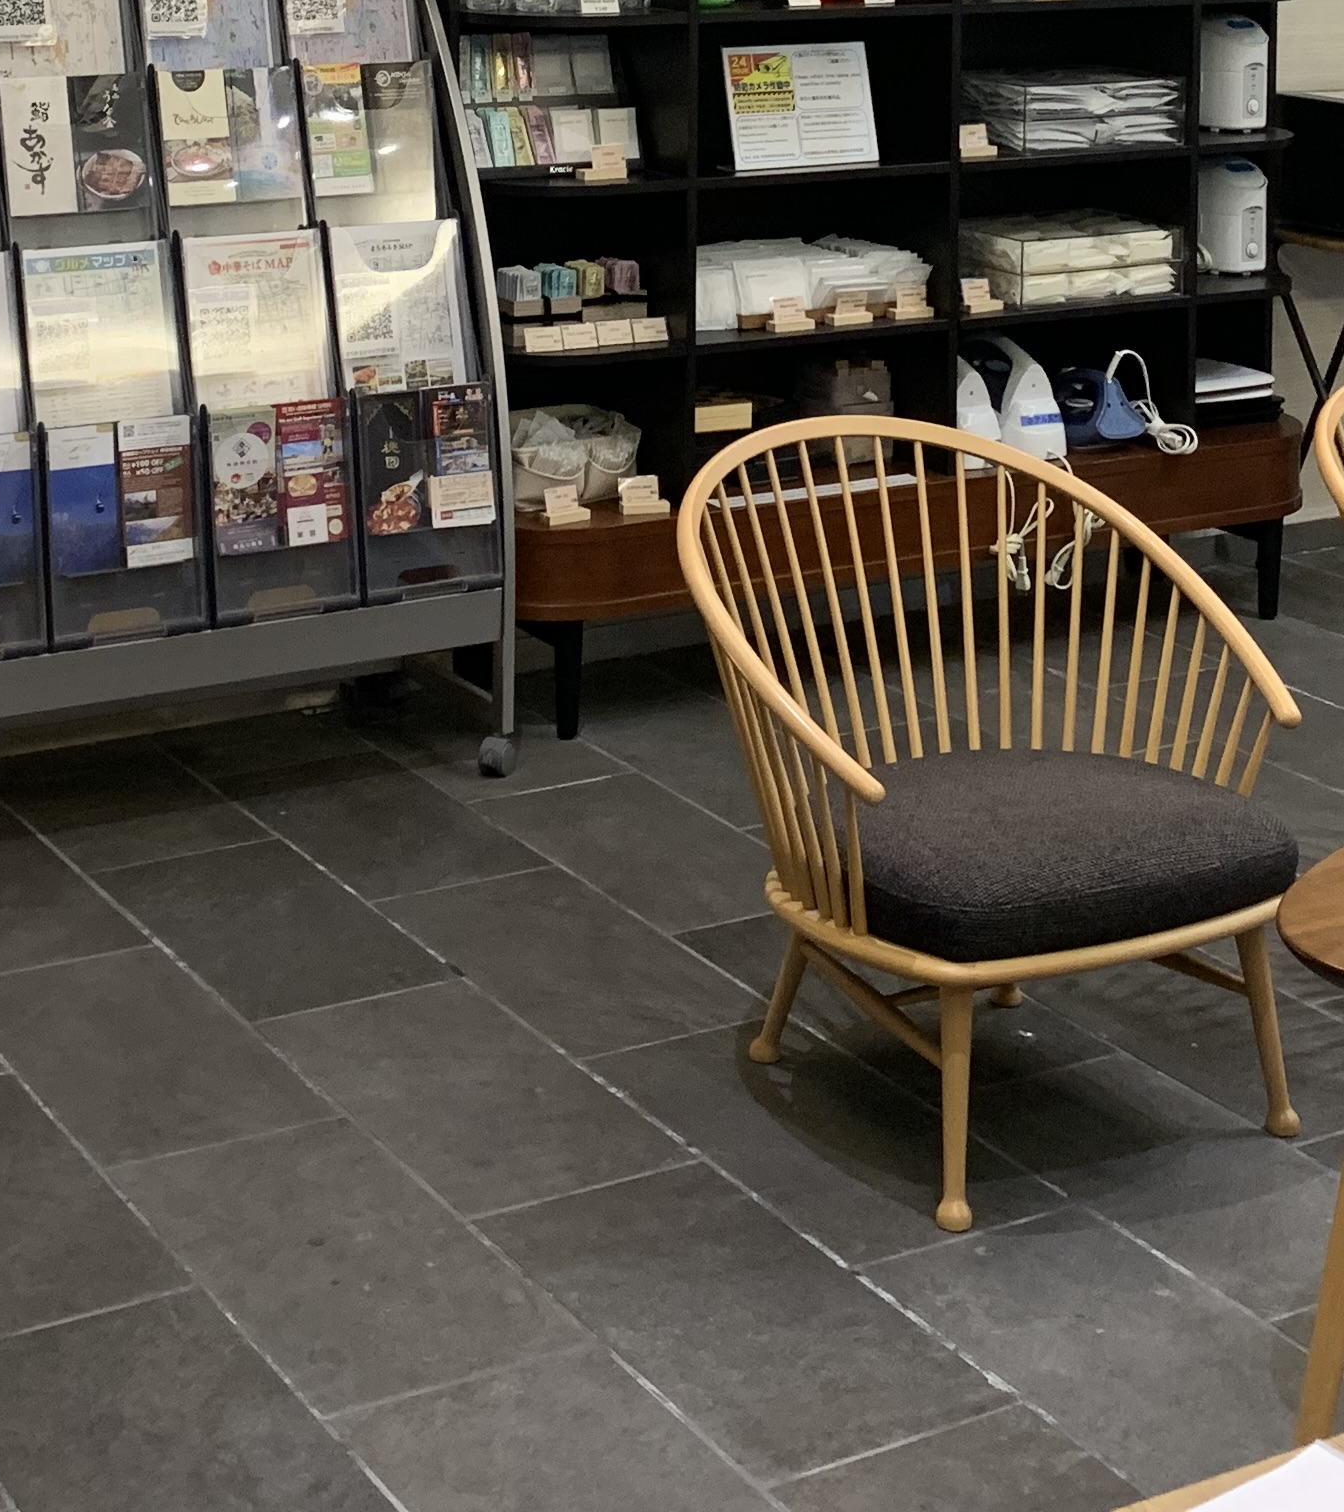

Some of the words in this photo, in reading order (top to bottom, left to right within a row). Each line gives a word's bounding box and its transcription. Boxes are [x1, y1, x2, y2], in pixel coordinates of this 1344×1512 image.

[731, 57, 747, 68] 24
[549, 166, 573, 174] Kracie
[54, 254, 126, 271] グルメマップ
[221, 259, 263, 275] 中華そば
[264, 256, 294, 271] MAP
